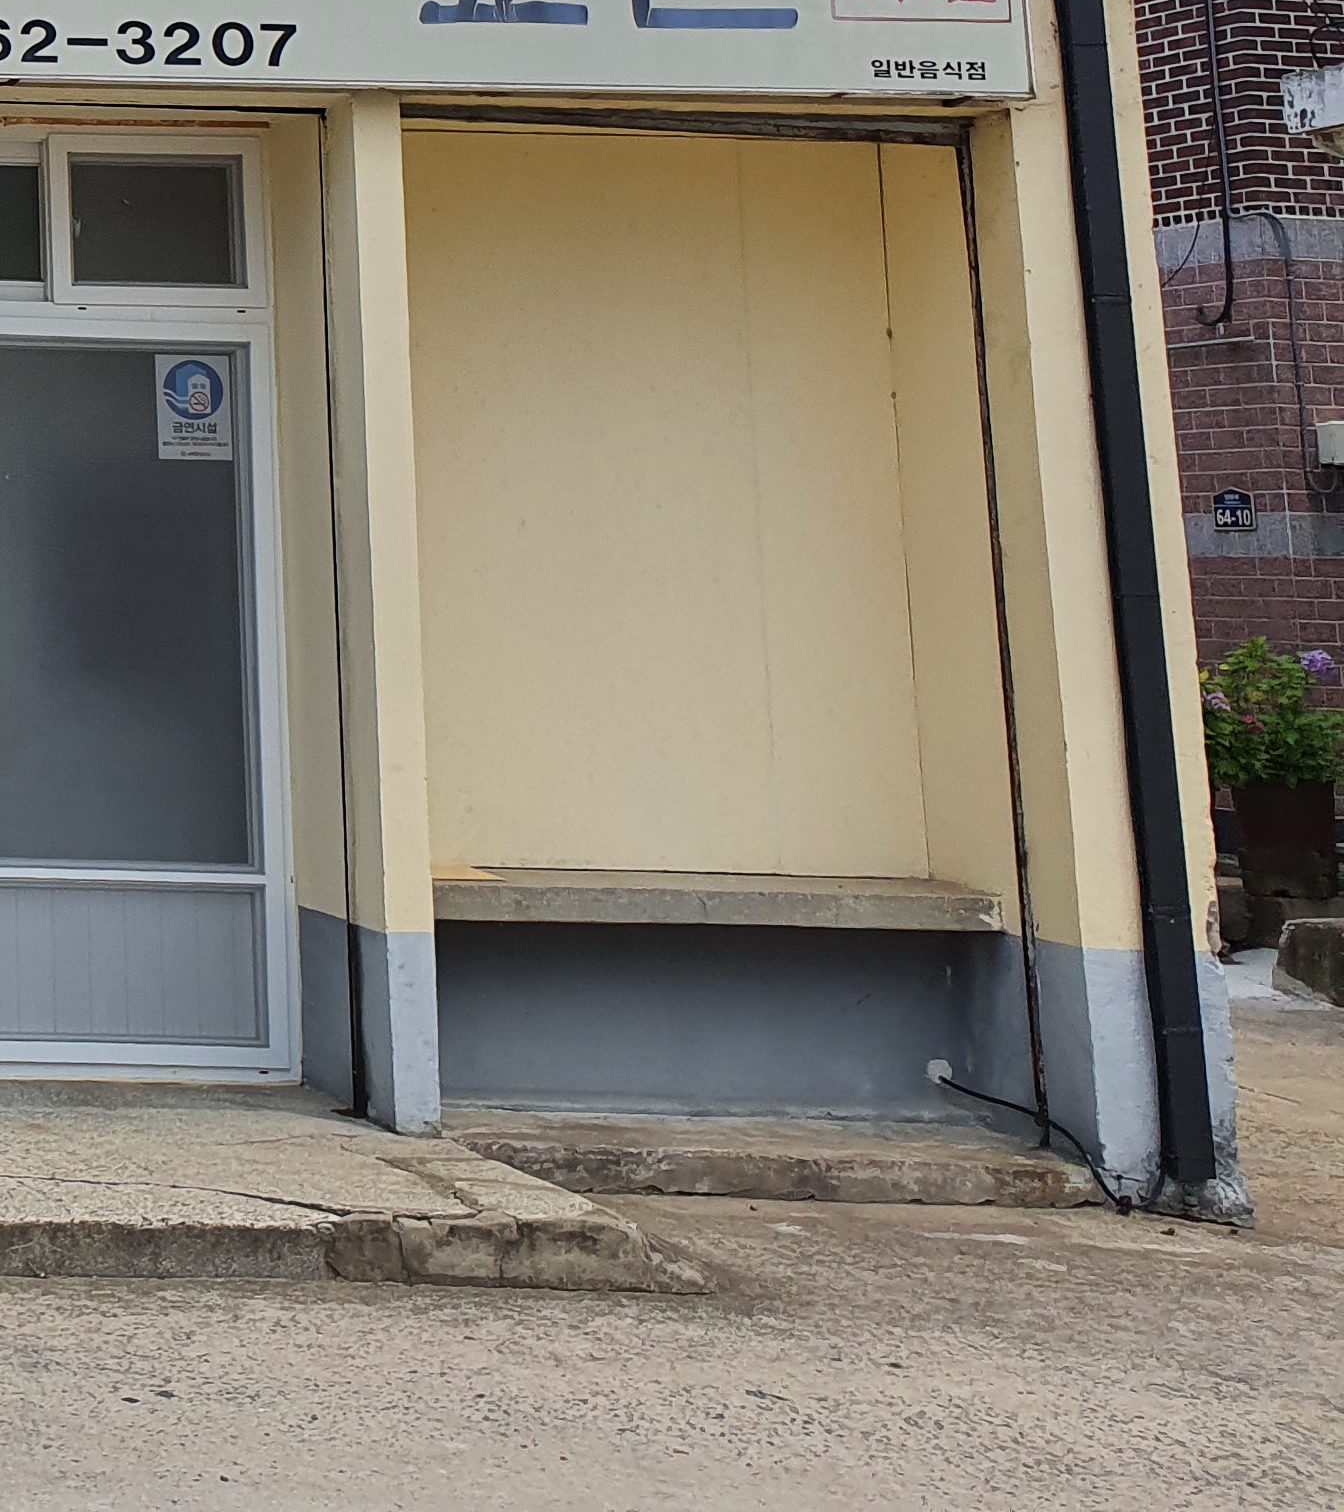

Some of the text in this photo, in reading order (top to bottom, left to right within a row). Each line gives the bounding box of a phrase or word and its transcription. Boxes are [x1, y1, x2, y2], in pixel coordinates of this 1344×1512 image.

[870, 59, 987, 81] 일반음식점
[172, 421, 218, 434] 금연시설
[1216, 508, 1251, 526] 64-10
